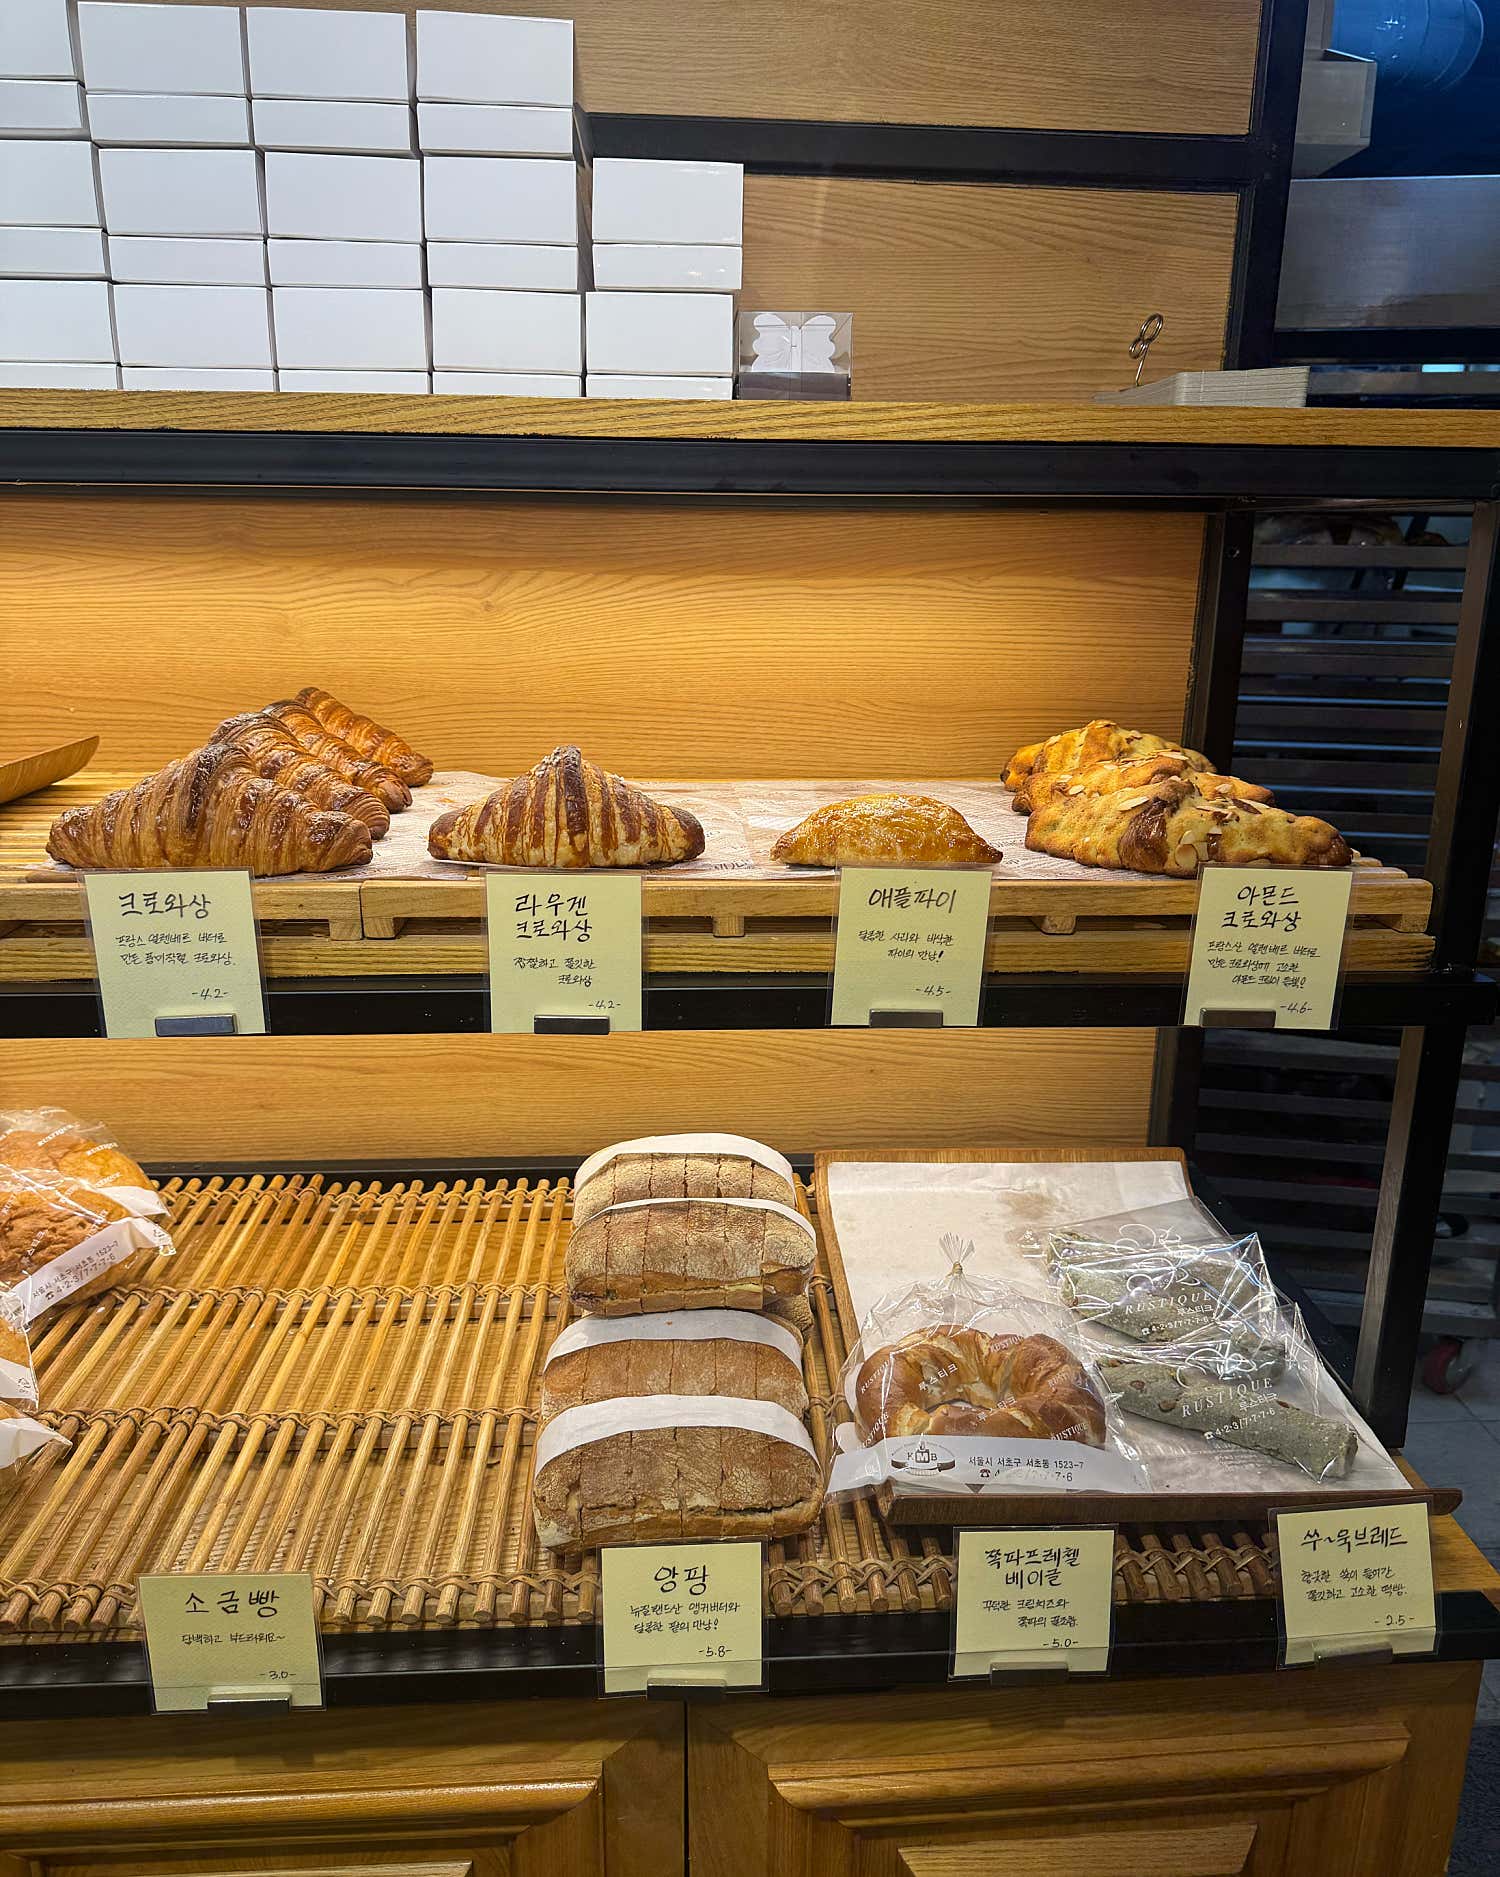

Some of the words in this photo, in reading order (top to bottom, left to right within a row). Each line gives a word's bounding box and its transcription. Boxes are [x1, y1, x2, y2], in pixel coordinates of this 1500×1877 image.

[869, 887, 956, 913] 애플파이
[1238, 886, 1299, 906] 아몬드
[119, 892, 210, 919] 크로와상
[516, 894, 588, 916] 라우겐
[1222, 911, 1301, 932] 크로와상
[517, 920, 592, 942] 크로와상
[858, 930, 885, 942] 달콤한
[927, 935, 954, 946] 바삭한
[116, 934, 146, 947] 프랑스
[199, 933, 227, 943] 버터로
[888, 948, 914, 958] 파이의
[918, 950, 944, 963] 만남!
[1208, 941, 1242, 952] 프랑스산
[1293, 946, 1320, 957] 버터로
[120, 953, 141, 965] 만든
[565, 958, 597, 968] 쫄깃한
[1276, 962, 1300, 972] 고소한
[558, 975, 592, 987] 크로와상
[1232, 975, 1256, 984] 아몬드
[1181, 1377, 1273, 1418] RUSTIQUE
[969, 1457, 993, 1466] 서울시
[998, 1458, 1021, 1467] 서초구
[1026, 1459, 1049, 1468] 서초동
[1054, 1460, 1084, 1469] 1523-7
[985, 1547, 1080, 1569] 쪽파프레첼
[655, 1565, 708, 1595] 앙팡
[1005, 1569, 1062, 1589] 베이글
[1363, 1567, 1395, 1578] 들어간
[1350, 1585, 1377, 1598] 고소한
[185, 1591, 280, 1618] 소금빵
[630, 1604, 682, 1618] 뉴질랜드산
[1017, 1599, 1069, 1609] 크림치즈와
[634, 1622, 663, 1633] 달콤한
[669, 1621, 689, 1633] 팥의
[693, 1618, 719, 1630] 만남!
[1018, 1616, 1046, 1627] 쪽파의
[181, 1634, 223, 1645] 담백하고
